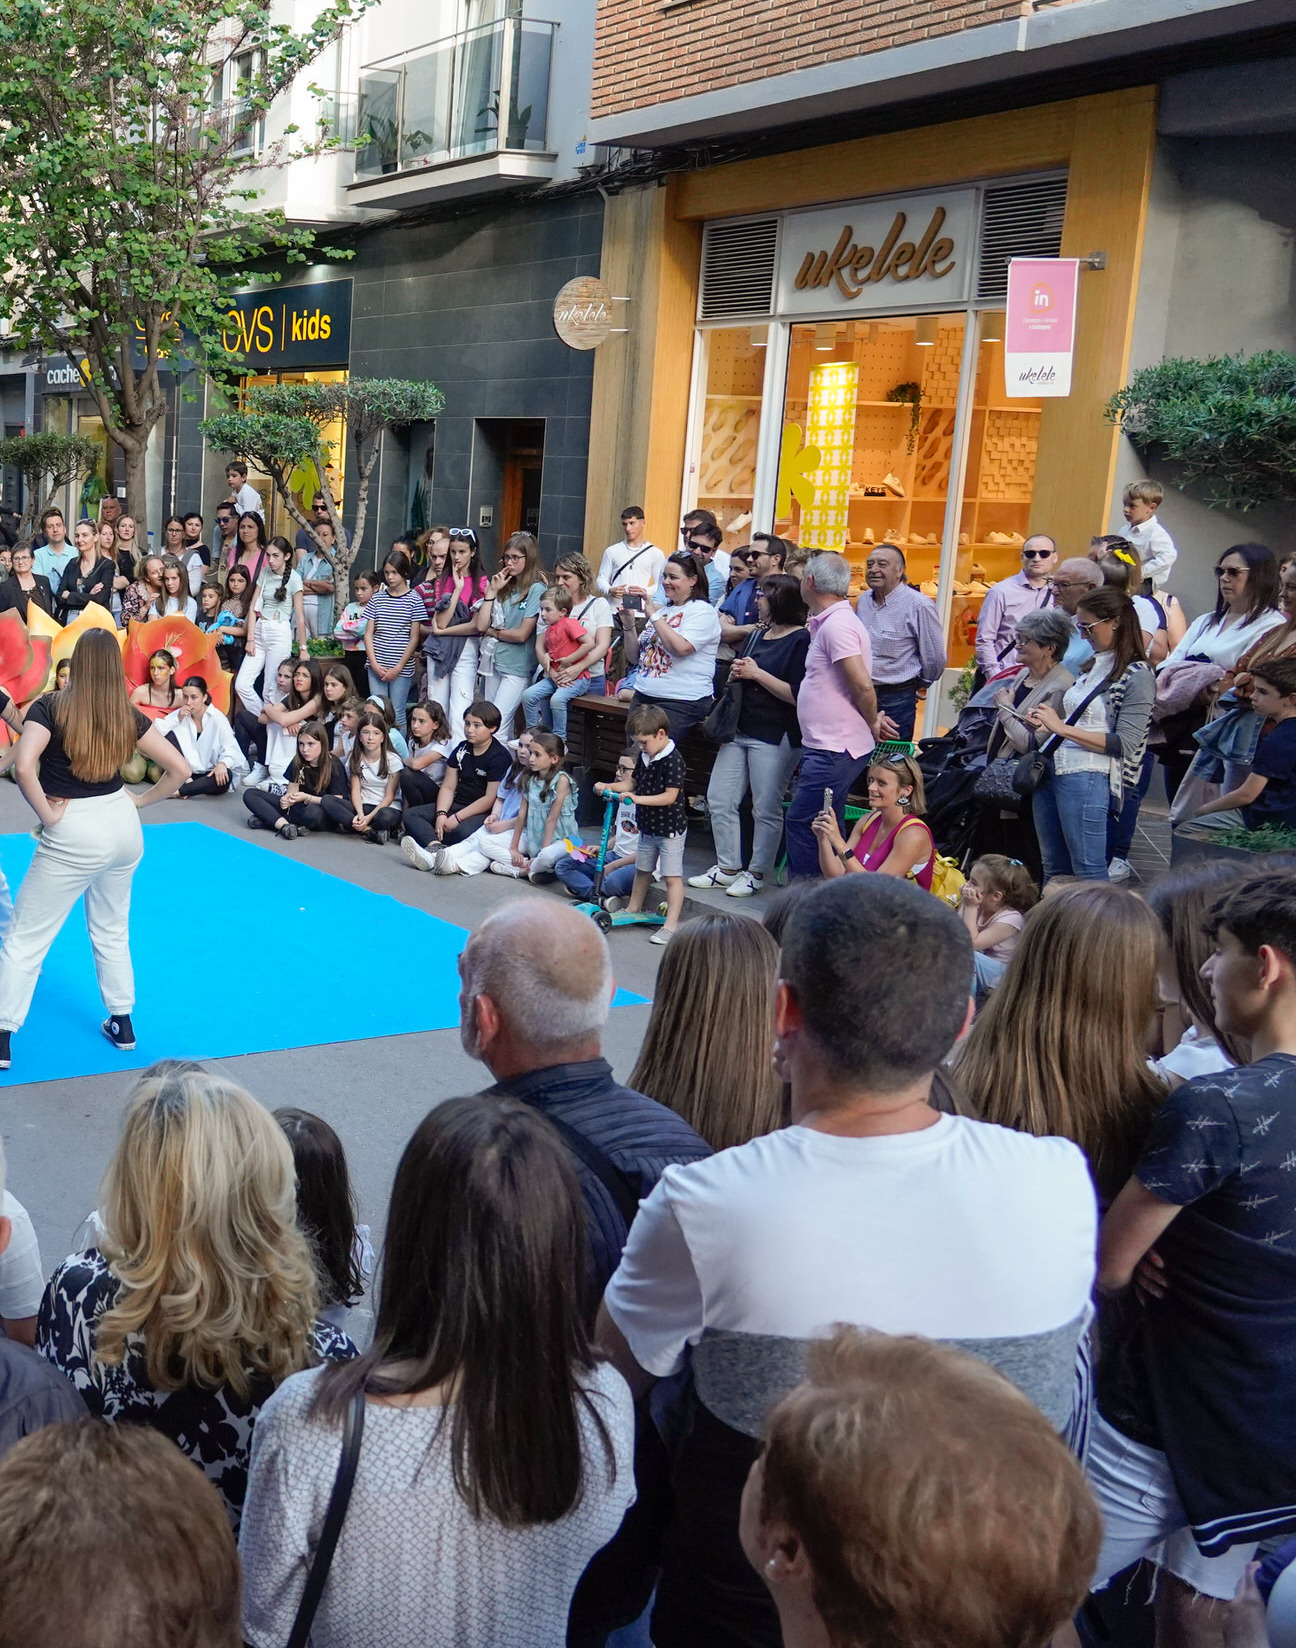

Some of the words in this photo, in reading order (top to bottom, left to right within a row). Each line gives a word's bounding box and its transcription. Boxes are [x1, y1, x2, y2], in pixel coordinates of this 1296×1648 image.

[795, 206, 956, 299] ukelele
[1034, 289, 1049, 307] in
[558, 302, 607, 326] ukelele
[222, 306, 274, 352] OVS
[291, 308, 332, 342] kids
[47, 364, 80, 384] cache
[1018, 365, 1056, 385] ukelele
